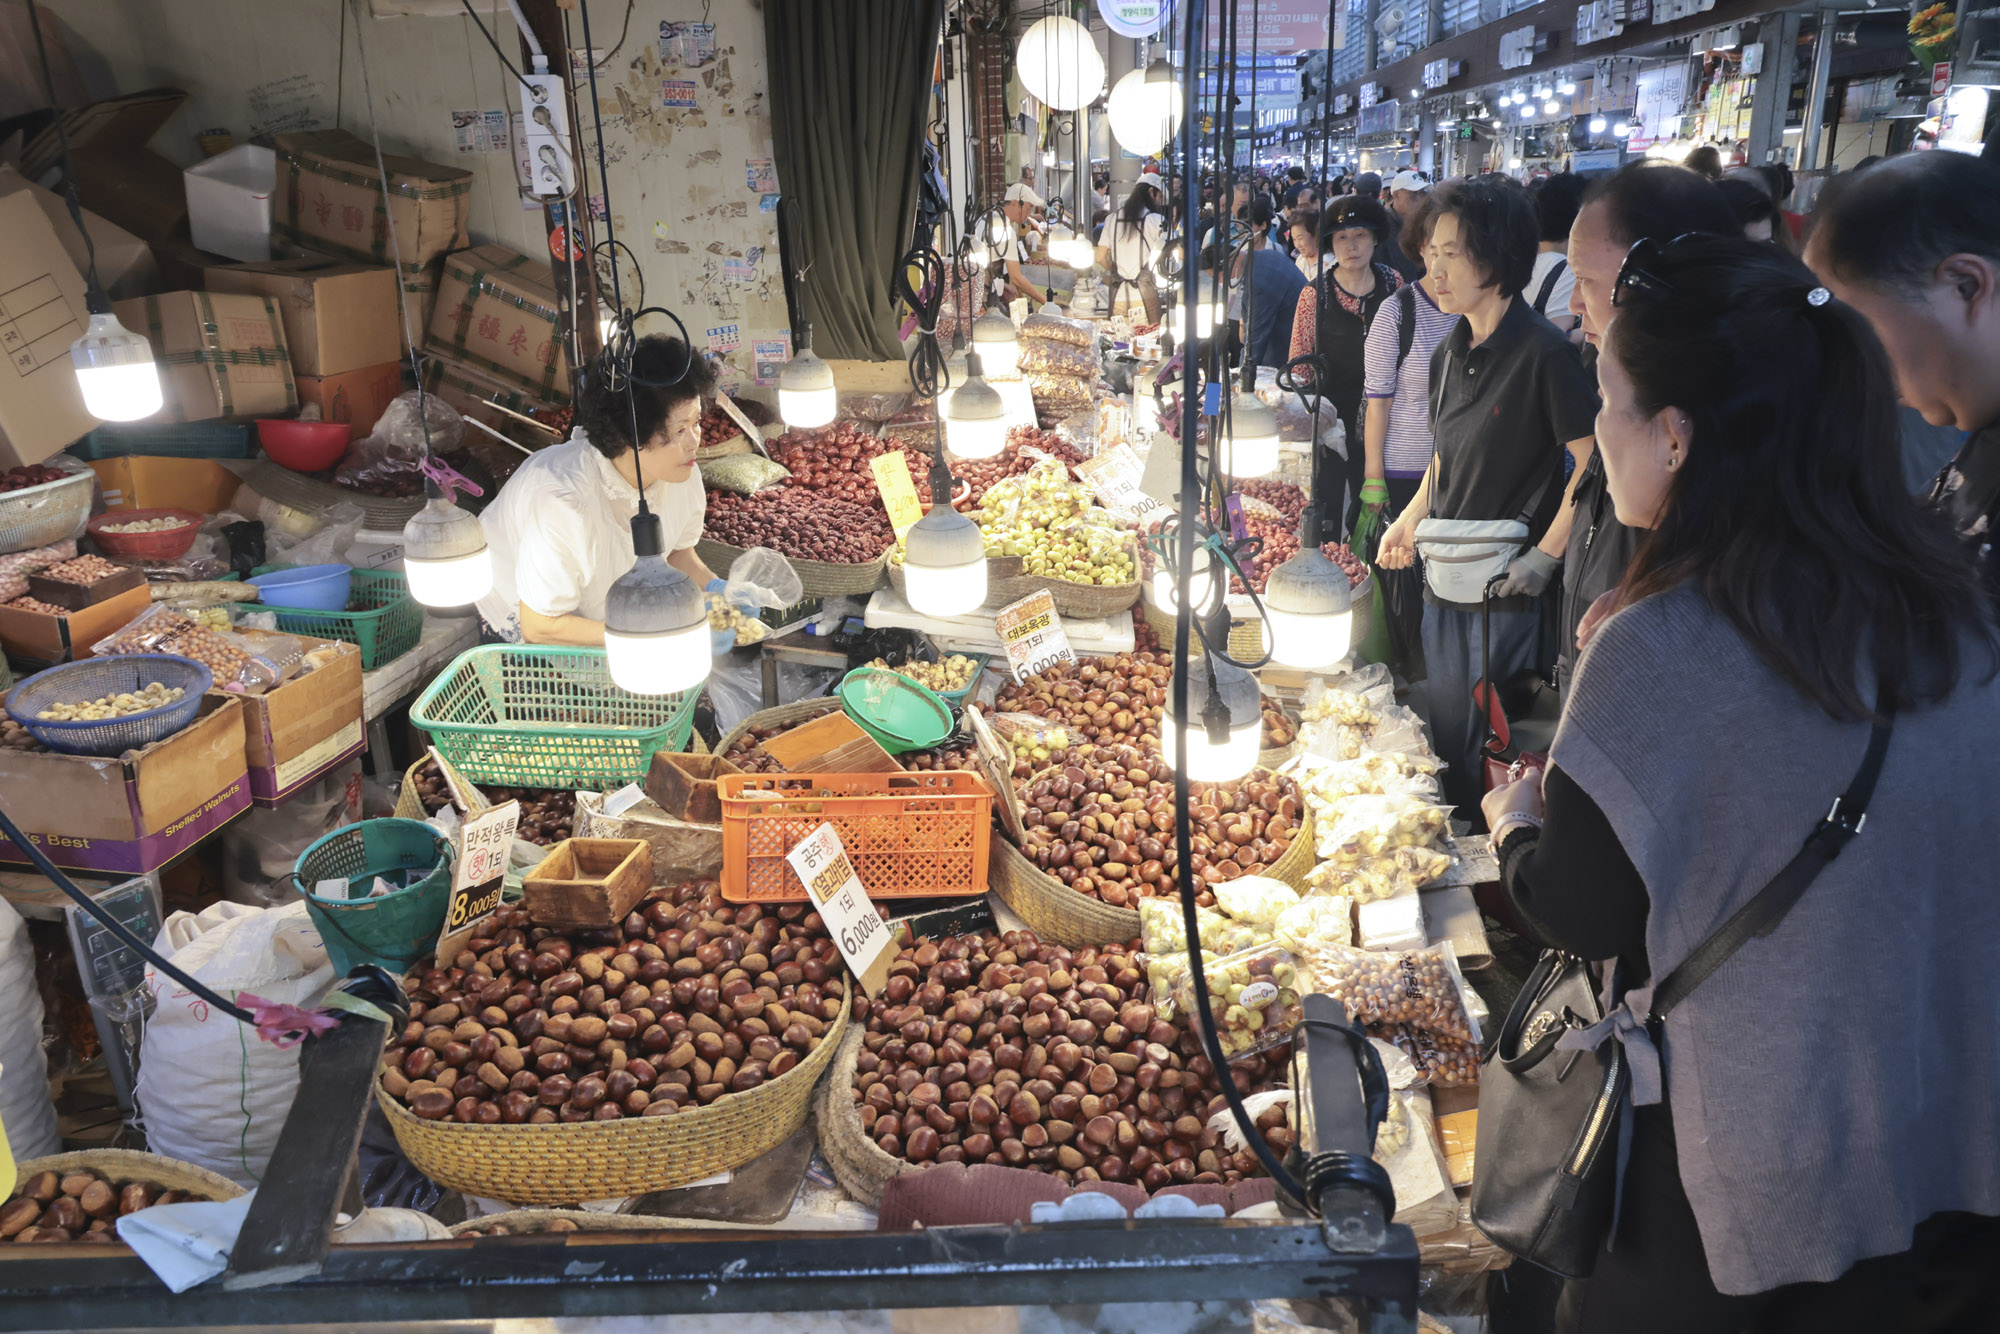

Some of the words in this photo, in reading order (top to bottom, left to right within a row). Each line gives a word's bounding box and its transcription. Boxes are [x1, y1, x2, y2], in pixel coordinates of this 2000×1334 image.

[1007, 613, 1050, 639] 대보옥광
[1025, 633, 1044, 649] 1되
[1017, 648, 1073, 681] 6000원
[165, 807, 202, 838] Shelled
[203, 783, 240, 813] Walnuts
[47, 835, 91, 849] Best
[467, 817, 516, 852] 만적왕특
[488, 849, 504, 869] 1되
[801, 840, 824, 868] 공주
[451, 888, 501, 926] 8,000원
[839, 890, 856, 914] 1되
[841, 911, 881, 955] 6,000원
